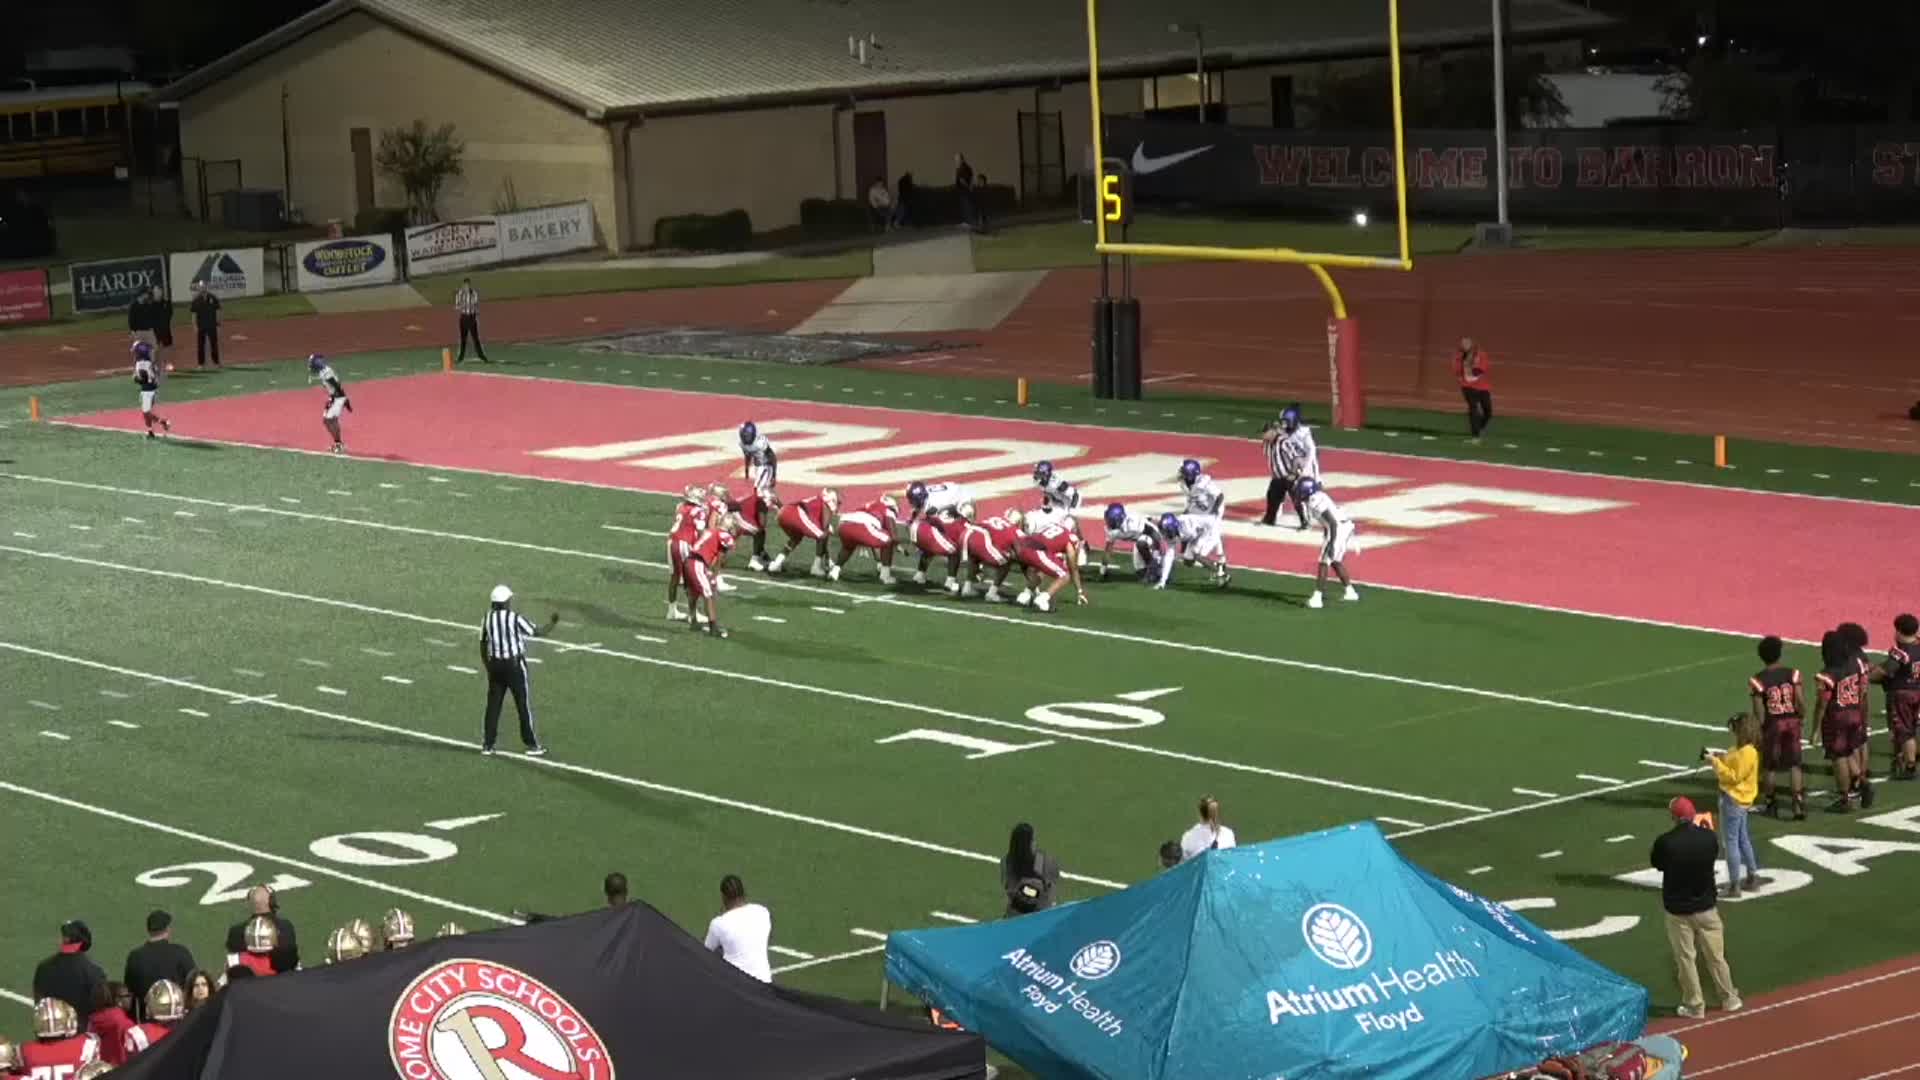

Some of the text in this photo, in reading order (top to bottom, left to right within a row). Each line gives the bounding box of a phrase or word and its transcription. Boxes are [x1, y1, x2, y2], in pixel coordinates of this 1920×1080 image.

[1508, 146, 1562, 189] TO
[1576, 145, 1776, 188] BARRON
[1103, 174, 1122, 222] 5
[508, 218, 582, 243] BAKERY
[79, 269, 155, 294] HARDY
[522, 418, 1641, 550] ROME
[874, 701, 1166, 760] 10
[135, 831, 459, 906] 20
[1001, 948, 1123, 1038] Atrium Health
[1020, 984, 1063, 1014] Floyd
[1265, 949, 1481, 1026] Atrium Health
[398, 966, 603, 1080] OME CITY SCHOOLS
[1354, 1001, 1425, 1035] Floyd
